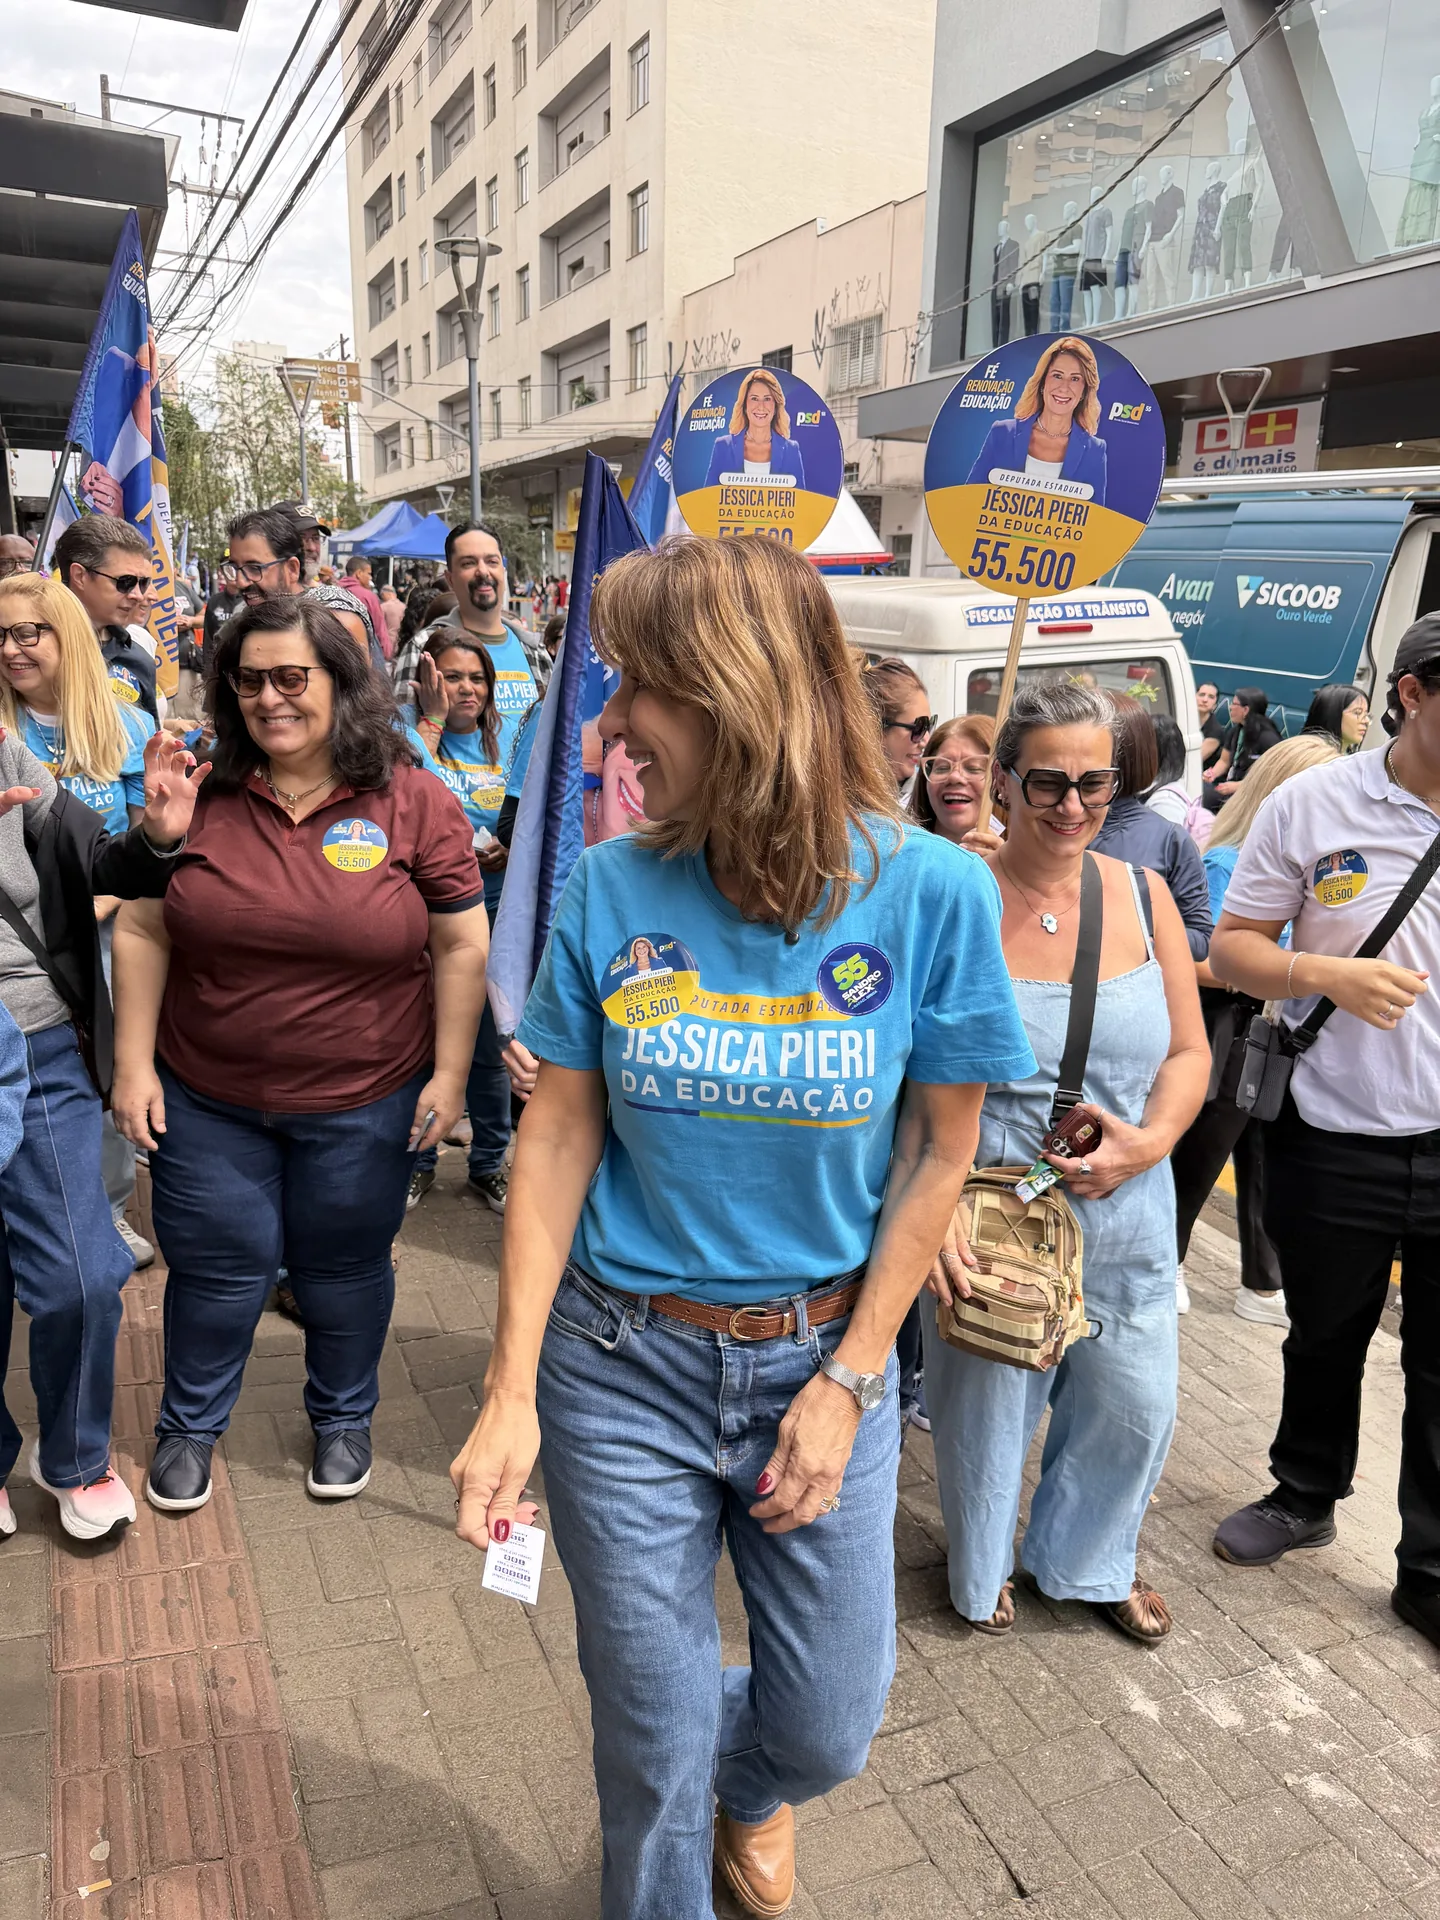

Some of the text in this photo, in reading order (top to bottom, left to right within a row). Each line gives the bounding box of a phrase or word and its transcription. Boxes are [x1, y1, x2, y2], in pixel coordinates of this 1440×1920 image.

[984, 362, 1000, 378] FÉ
[966, 379, 1014, 395] RENOVAÇÃO
[703, 394, 713, 408] FÉ
[960, 394, 1012, 412] EDUCAÇÃO
[692, 406, 726, 418] RENOVAÇÃO
[796, 410, 821, 426] psd
[1109, 402, 1145, 420] psd
[690, 416, 726, 432] EDUCAÇÃO
[1194, 456, 1206, 472] é
[728, 476, 789, 485] DEPUTADA ESTADUAL
[1000, 474, 1084, 496] DEPUTADA ESTADUAL
[719, 486, 796, 508] JÉSSICA PIERI
[718, 508, 795, 520] DA EDUCAÇÃO
[982, 486, 1090, 526] JÉSSICA PIERI
[978, 514, 1083, 541] DA EDUCAÇÃO
[968, 538, 1076, 591] 55.500
[1256, 582, 1342, 610] SICOOB
[969, 600, 1147, 623] FISCALAÇÃO DE TRÂNSITO
[1276, 608, 1333, 624] Ouro Verde
[336, 856, 370, 868] 55.500
[1324, 888, 1353, 903] 55.500
[832, 952, 868, 990] 55
[654, 975, 676, 988] PIERI
[842, 970, 881, 1000] SANDRO
[636, 986, 676, 1000] EDUCAÇÃO
[626, 996, 680, 1024] 55.500
[779, 1028, 876, 1079] PIERI
[621, 1069, 874, 1117] DA EDUCAÇÃO
